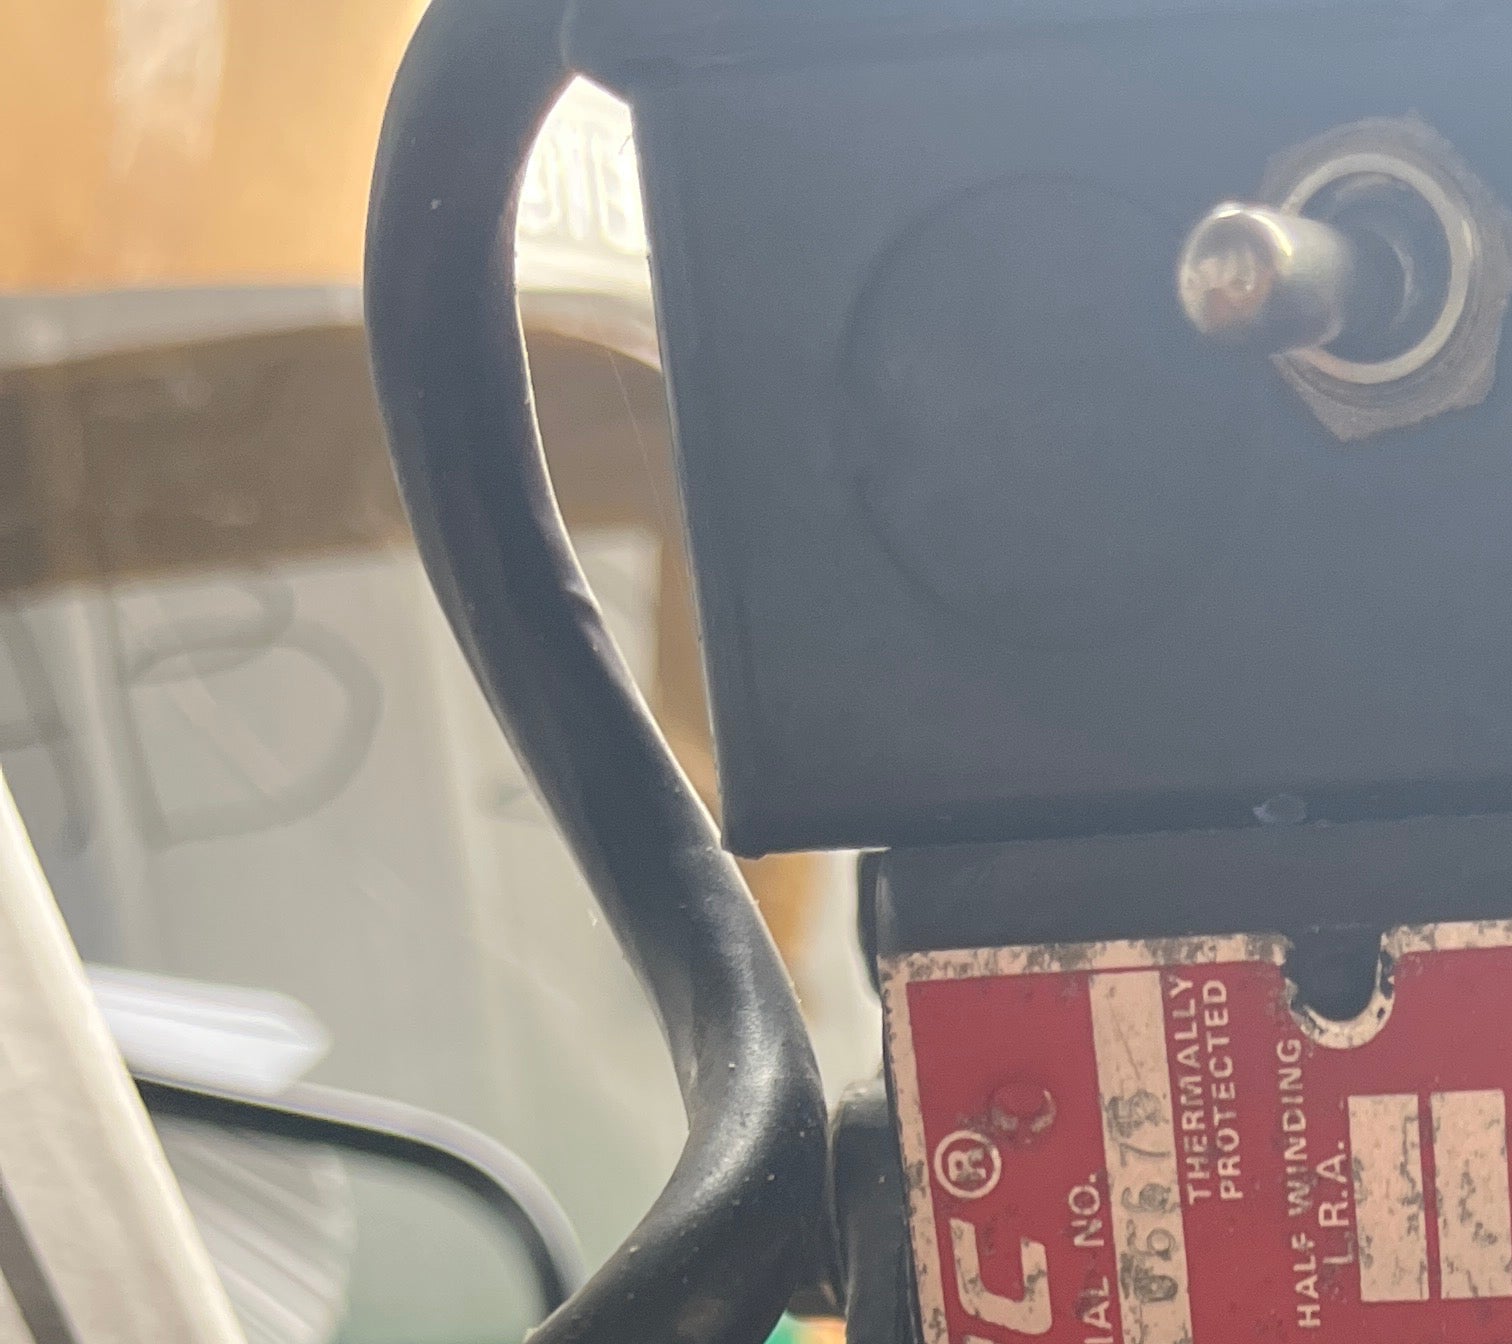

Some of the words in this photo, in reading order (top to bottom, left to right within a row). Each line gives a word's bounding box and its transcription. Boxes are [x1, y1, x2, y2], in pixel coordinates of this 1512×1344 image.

[1168, 973, 1212, 1203] THERMALLY
[1202, 978, 1243, 1198] PROTECTED
[1277, 1038, 1312, 1214] WINDING
[1068, 1173, 1104, 1247] NO.
[1294, 1231, 1322, 1326] HALF
